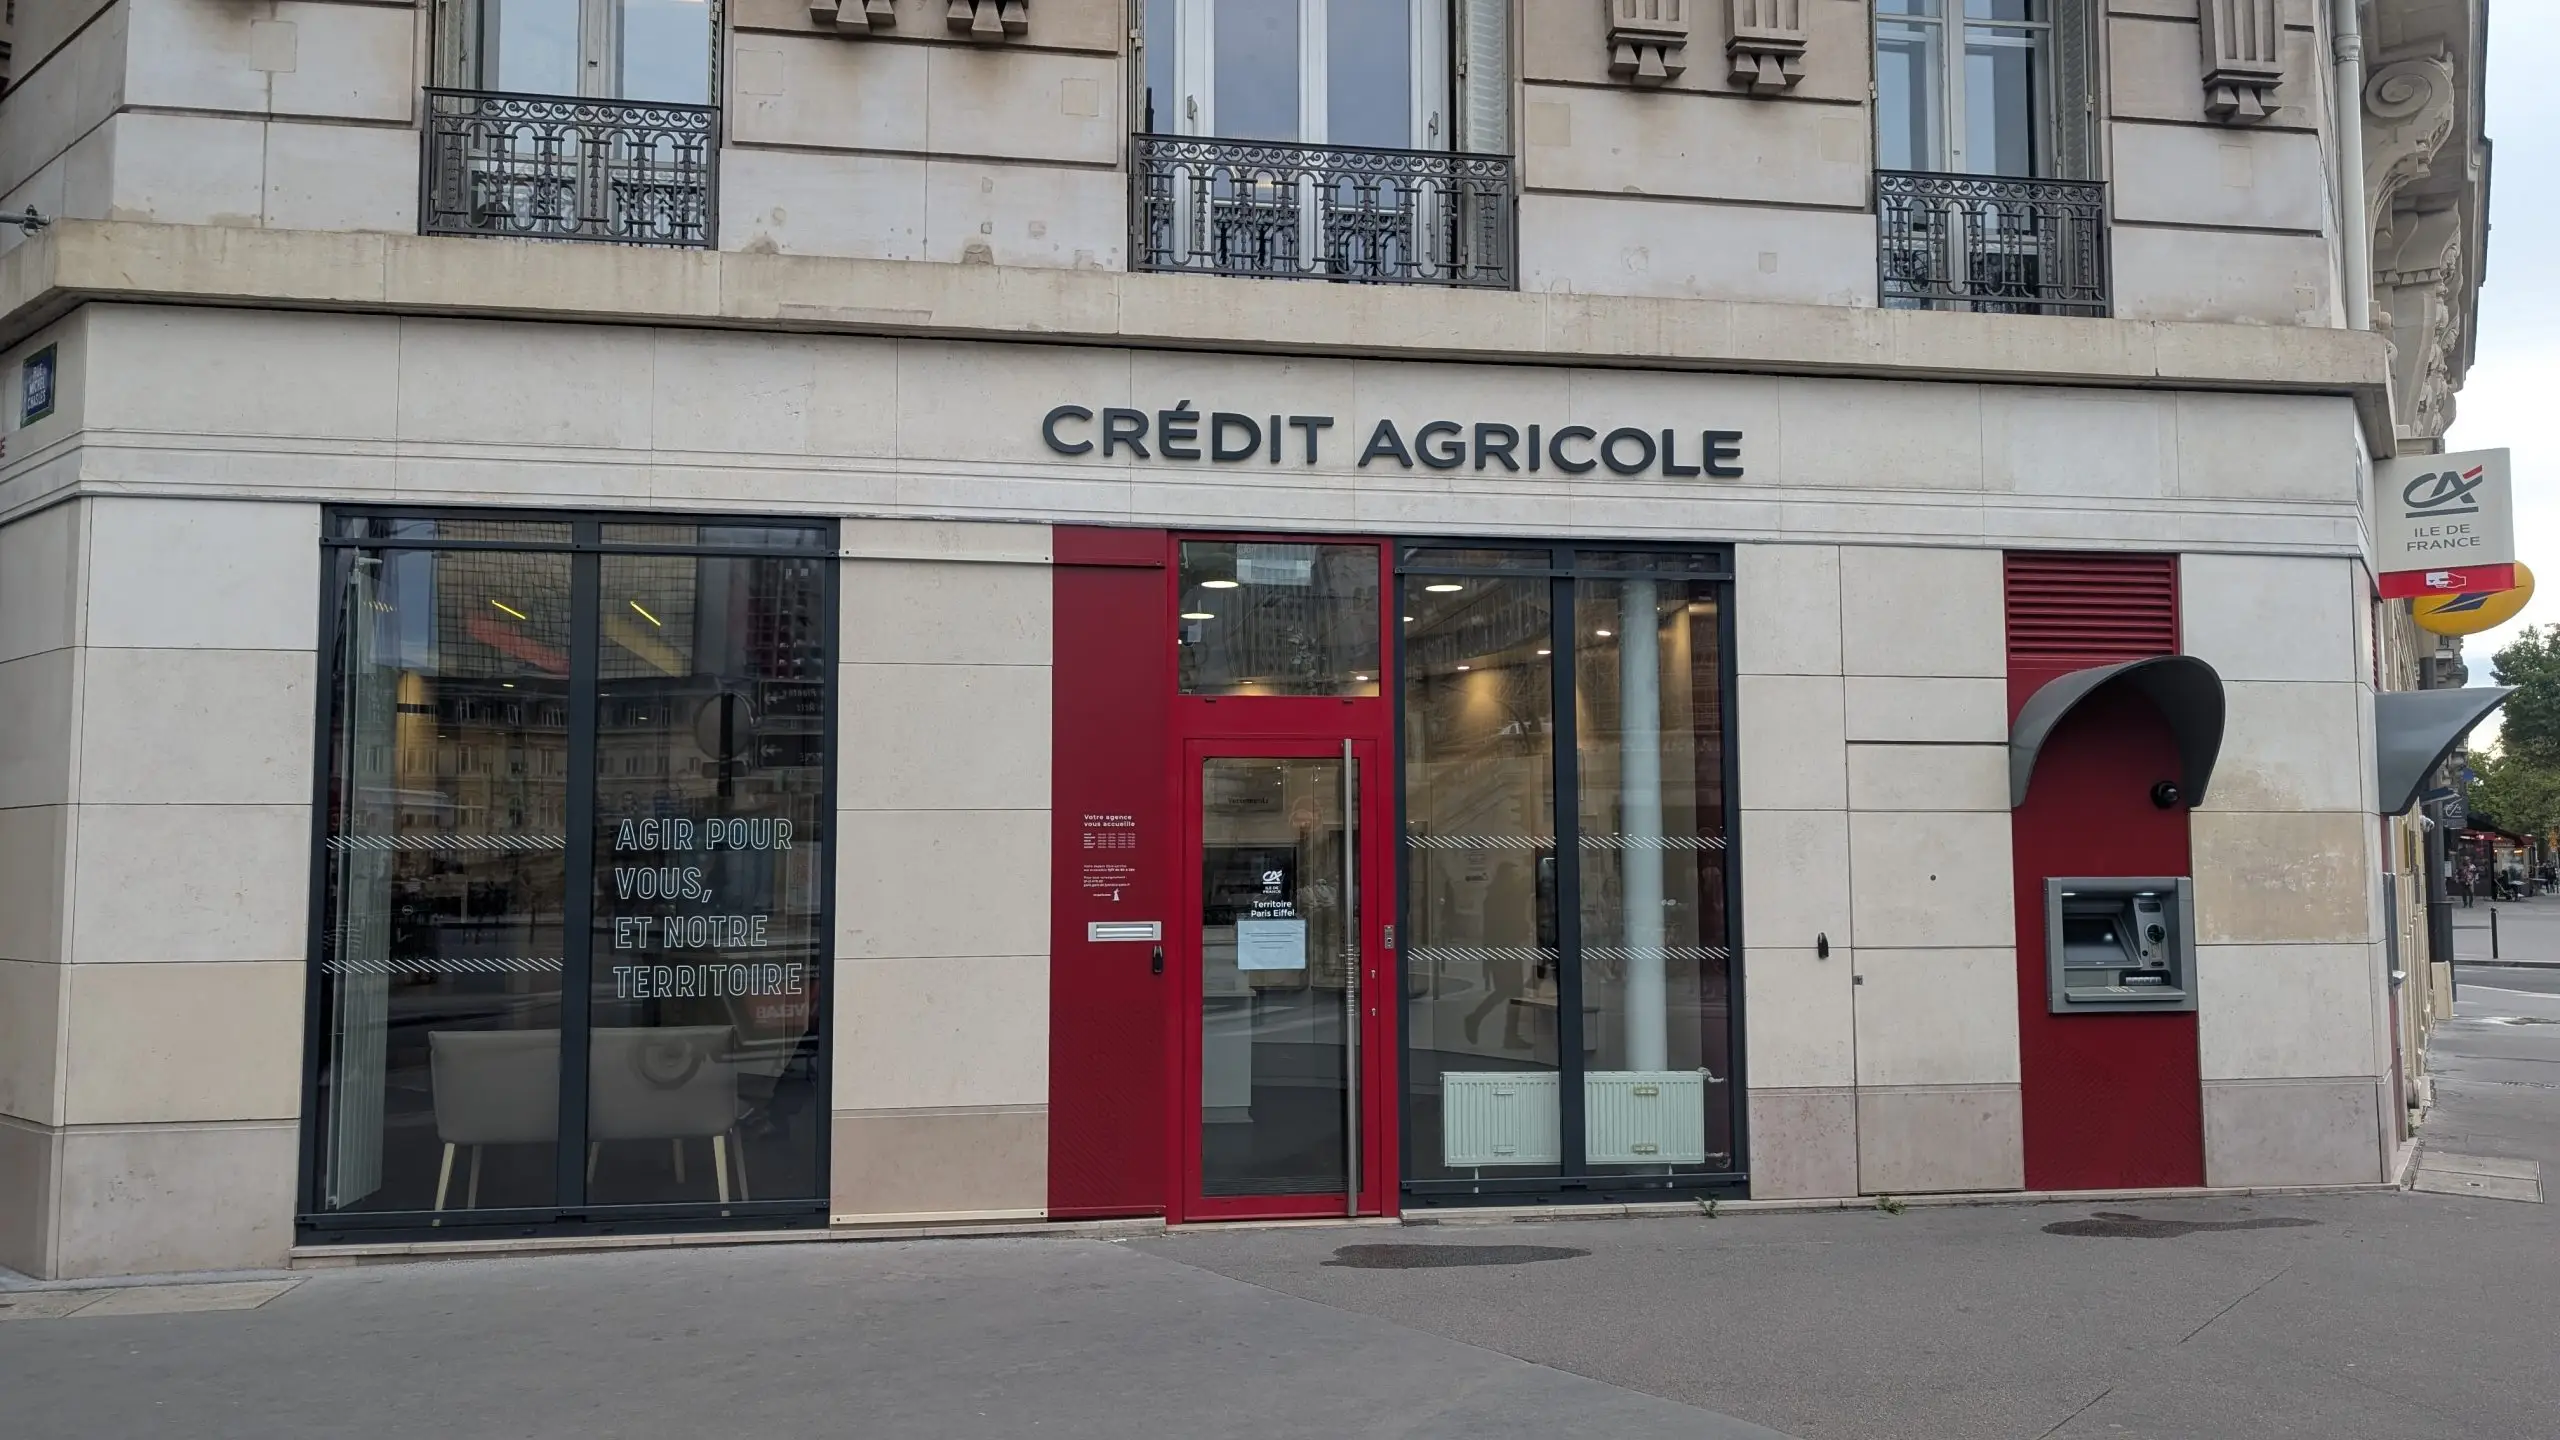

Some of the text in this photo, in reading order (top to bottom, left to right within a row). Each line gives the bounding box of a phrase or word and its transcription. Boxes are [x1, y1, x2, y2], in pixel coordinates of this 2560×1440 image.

[1042, 401, 1744, 477] CRÉDIT AGRICOLE
[2406, 536, 2481, 552] FRANCE
[2414, 524, 2471, 537] ILE DE
[616, 818, 793, 850] AGIR POUR
[615, 867, 712, 903] VOUS,
[1253, 900, 1292, 908] Territoire
[1274, 909, 1295, 917] Eiffel
[615, 915, 768, 948] ET NOTRE
[613, 963, 802, 998] TERRITOIRE
